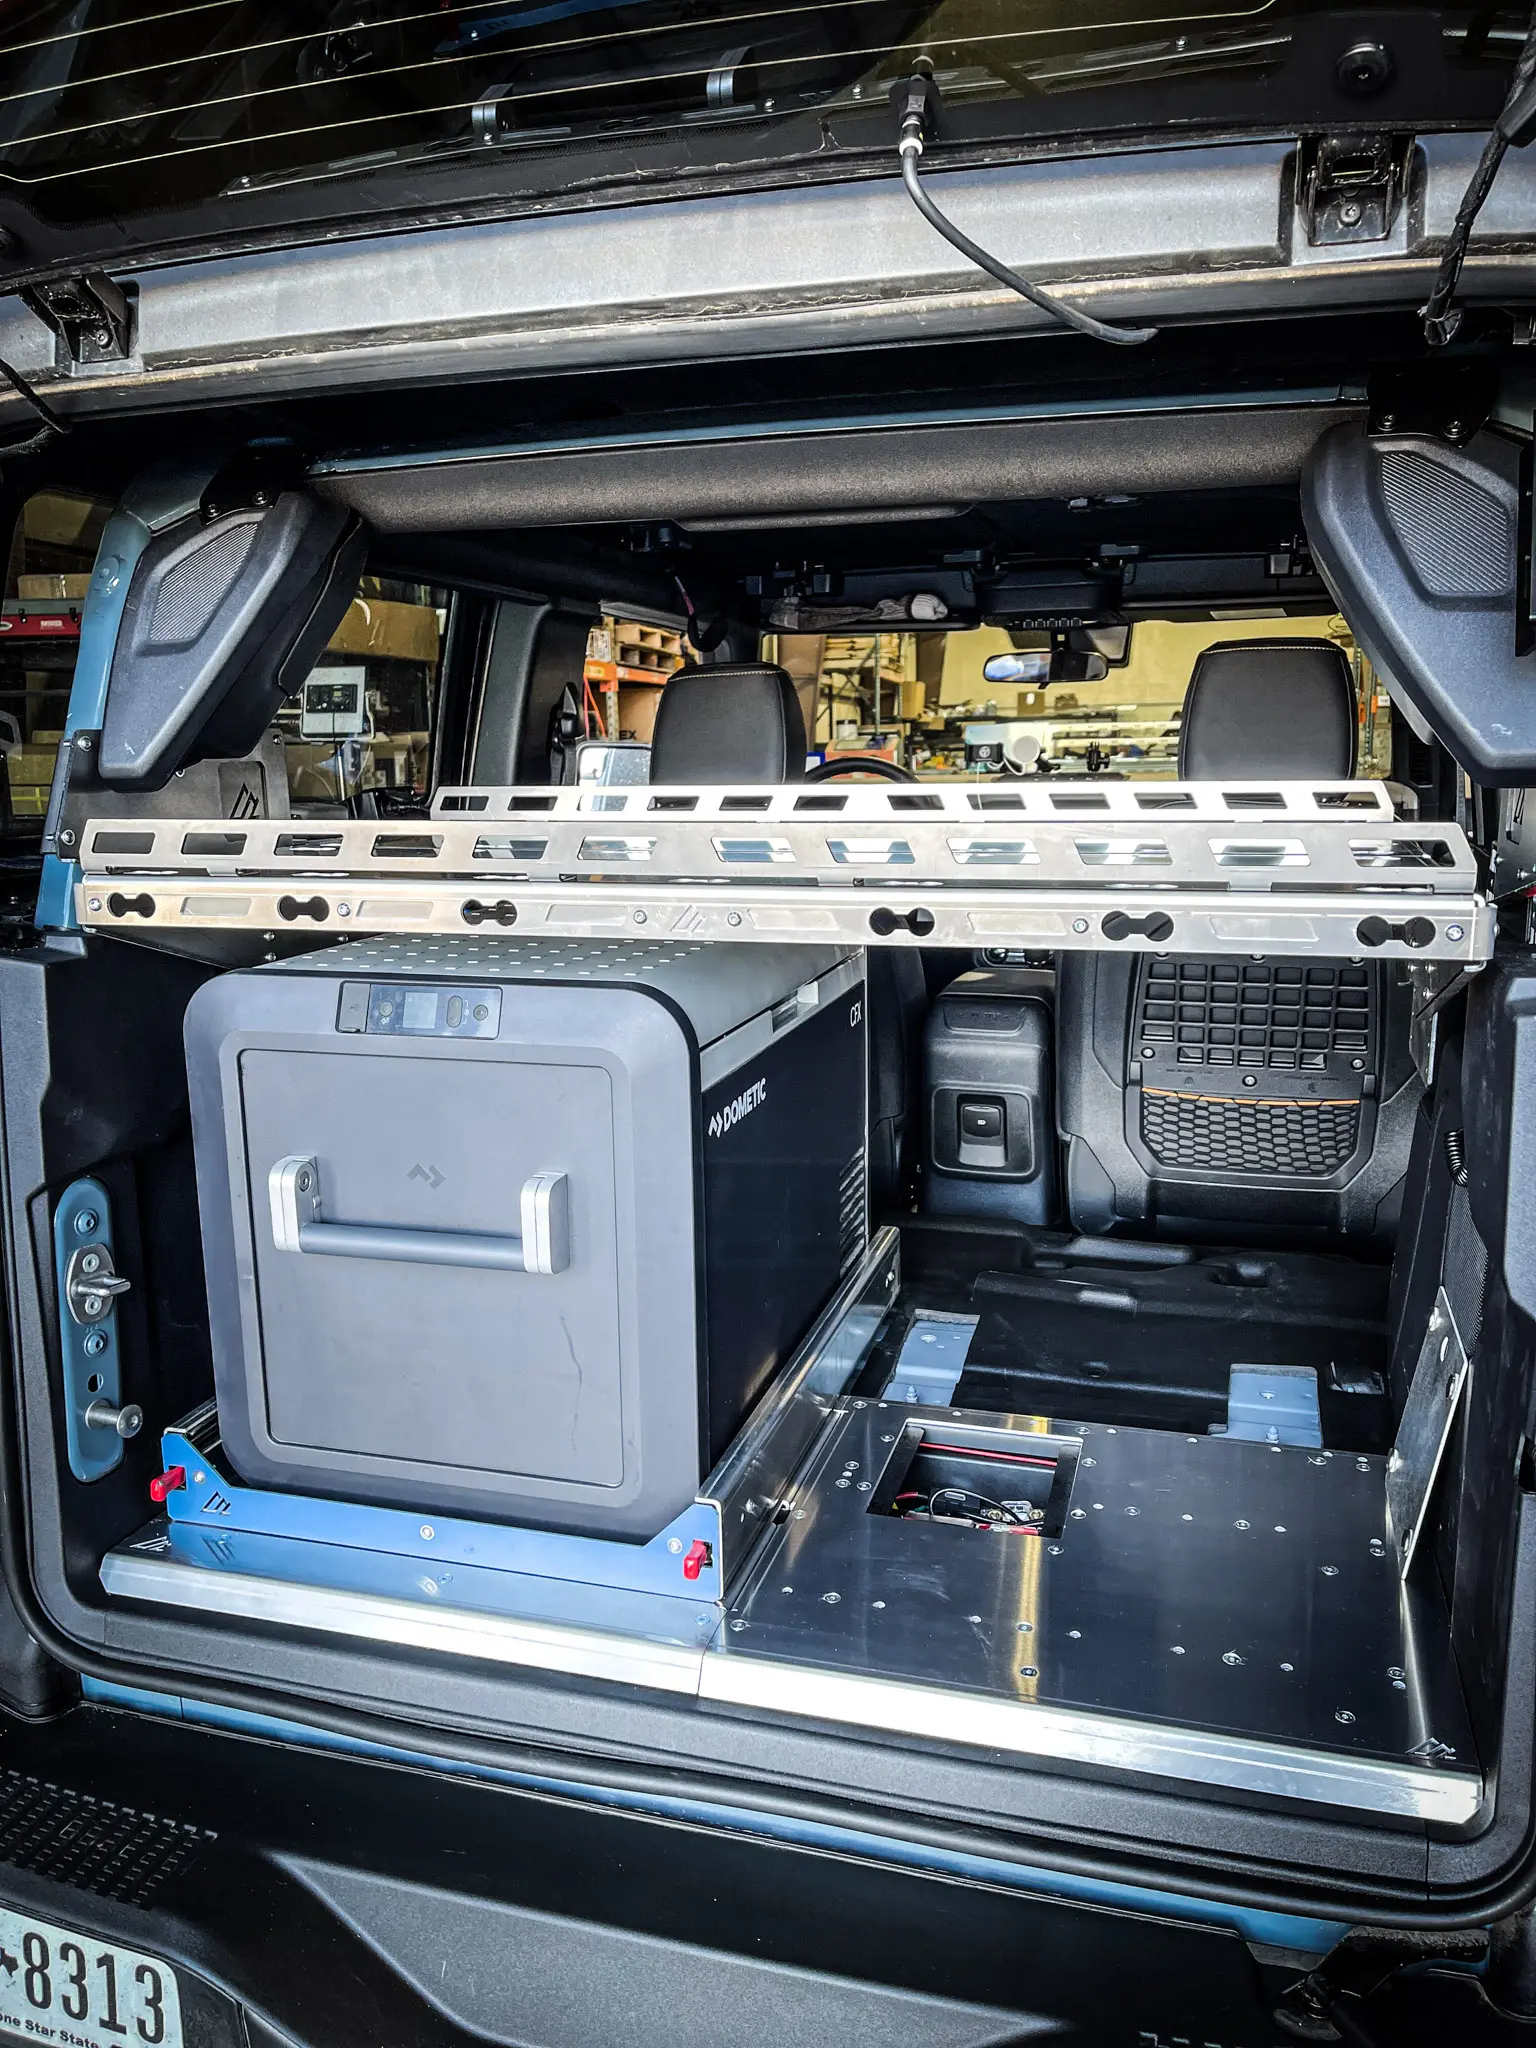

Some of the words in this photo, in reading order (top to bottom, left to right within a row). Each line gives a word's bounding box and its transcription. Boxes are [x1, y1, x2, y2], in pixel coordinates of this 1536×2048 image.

[850, 1000, 862, 1028] CFX
[723, 1077, 767, 1132] DOMETIC
[22, 1931, 166, 2044] 8313
[25, 2019, 56, 2037] Star
[60, 2030, 99, 2048] State
